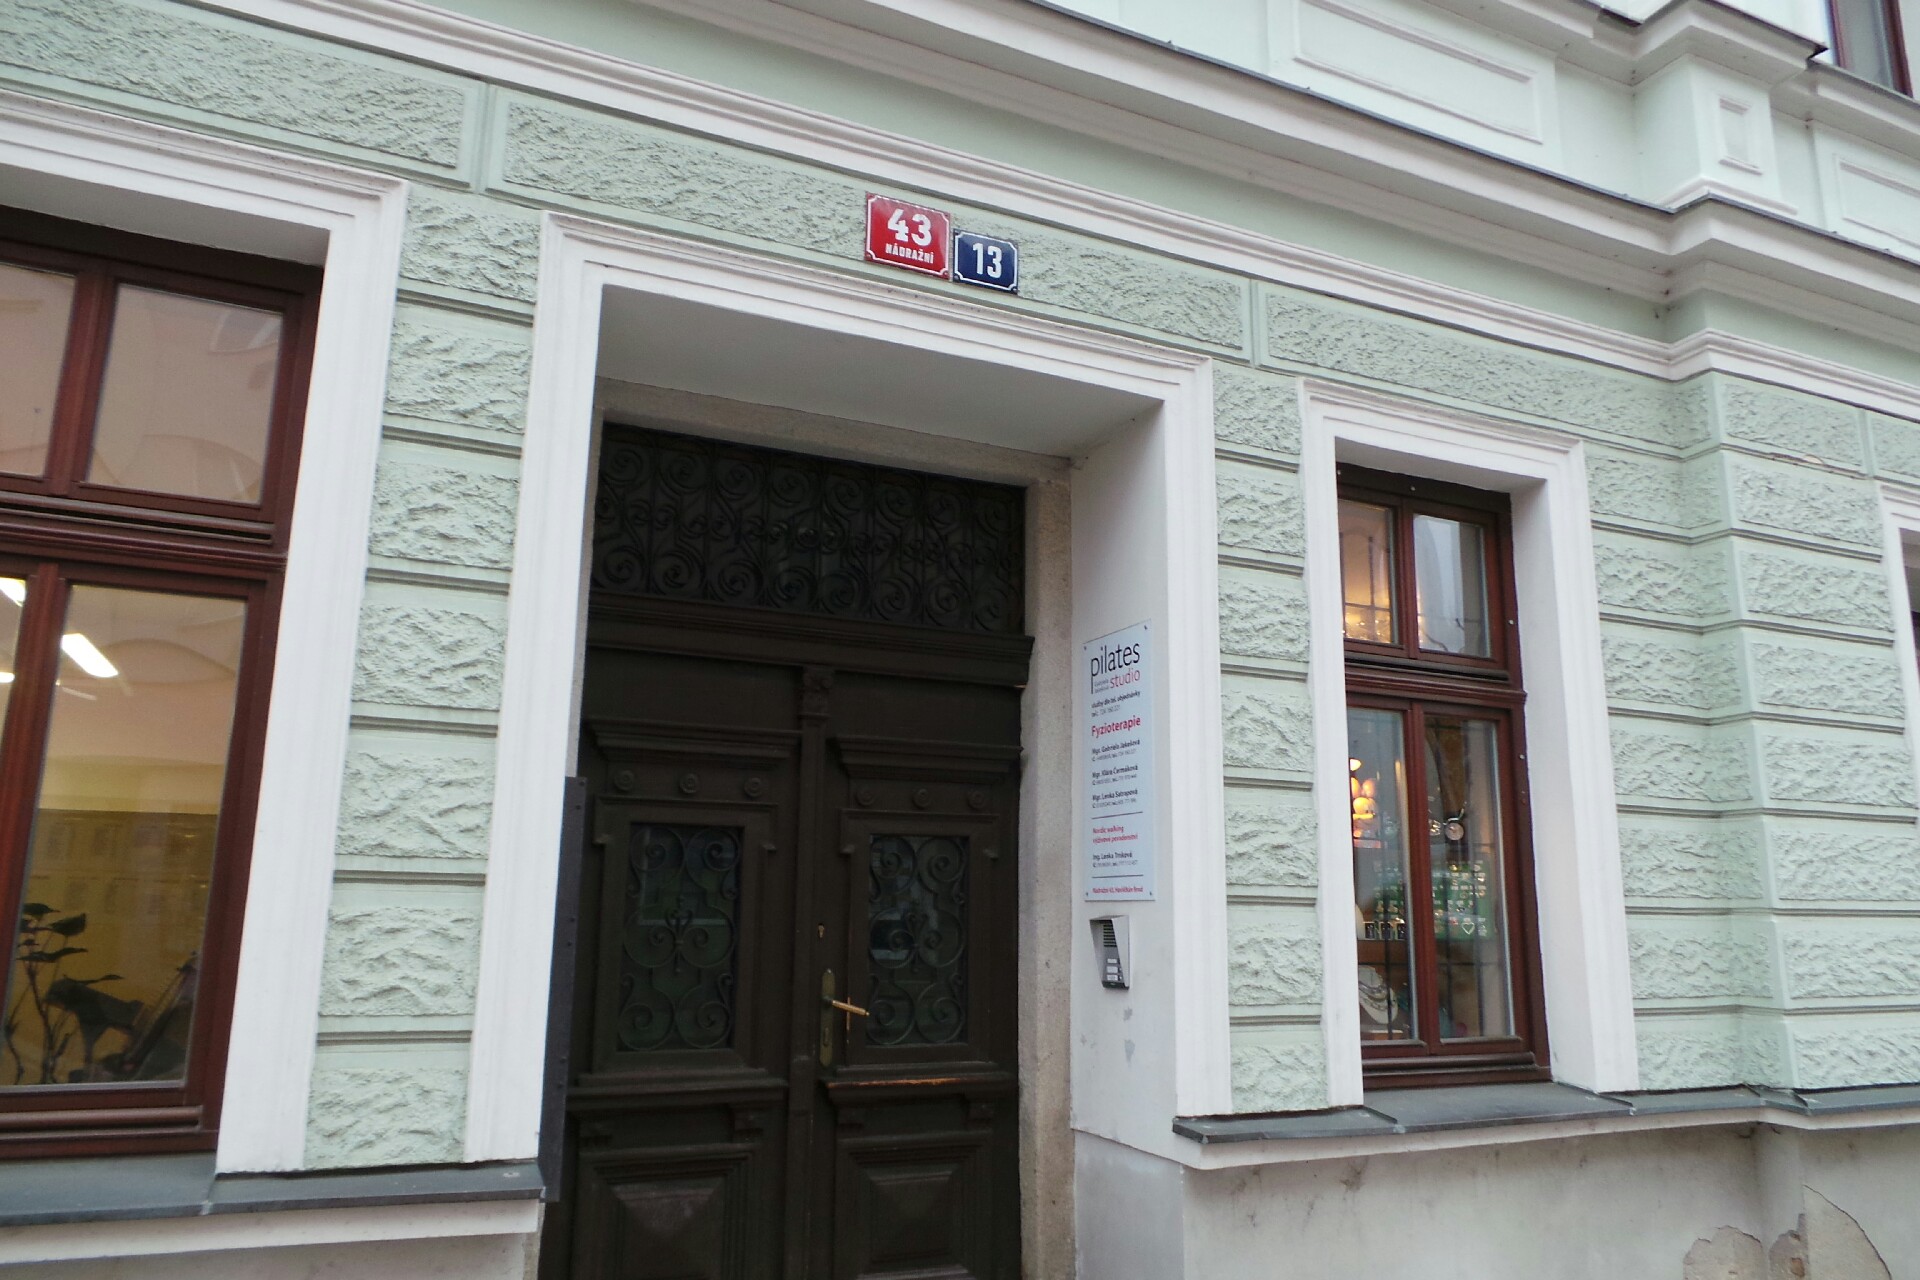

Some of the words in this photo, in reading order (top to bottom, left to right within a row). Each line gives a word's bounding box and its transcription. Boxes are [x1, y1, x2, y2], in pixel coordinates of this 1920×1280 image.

[887, 208, 932, 246] 43
[885, 242, 934, 264] NÁDRAŽNÍ
[972, 242, 1003, 279] 13
[1090, 643, 1141, 694] pilates
[1110, 667, 1141, 689] studio
[1091, 715, 1141, 738] Fyzioterapie
